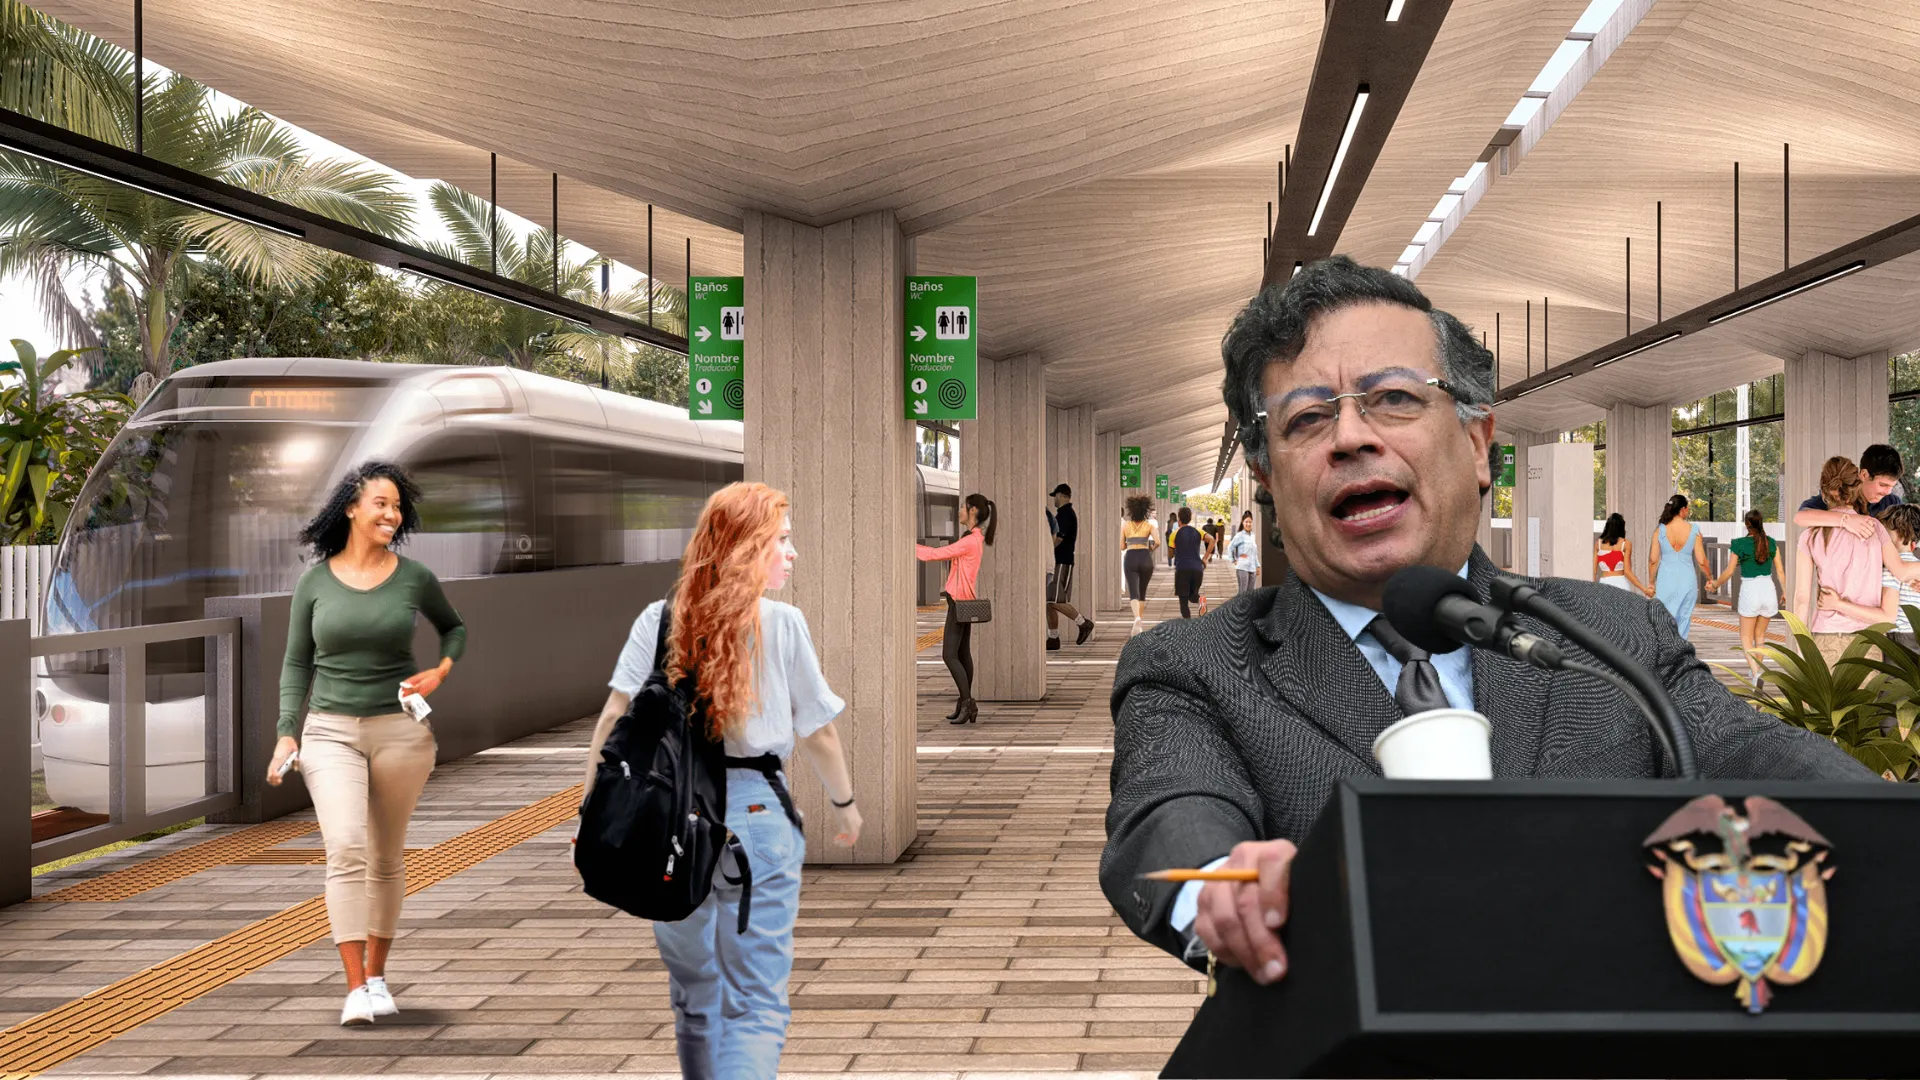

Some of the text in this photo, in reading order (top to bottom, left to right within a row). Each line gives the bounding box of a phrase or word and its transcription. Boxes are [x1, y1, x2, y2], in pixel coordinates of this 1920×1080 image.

[694, 282, 729, 292] Baños
[909, 281, 944, 292] Baños
[695, 292, 708, 300] WC
[910, 292, 924, 300] WC
[694, 353, 740, 363] Nombre
[909, 353, 955, 363] Nombre
[910, 363, 952, 372] Traducción
[700, 381, 707, 391] 1
[916, 381, 922, 391] 1
